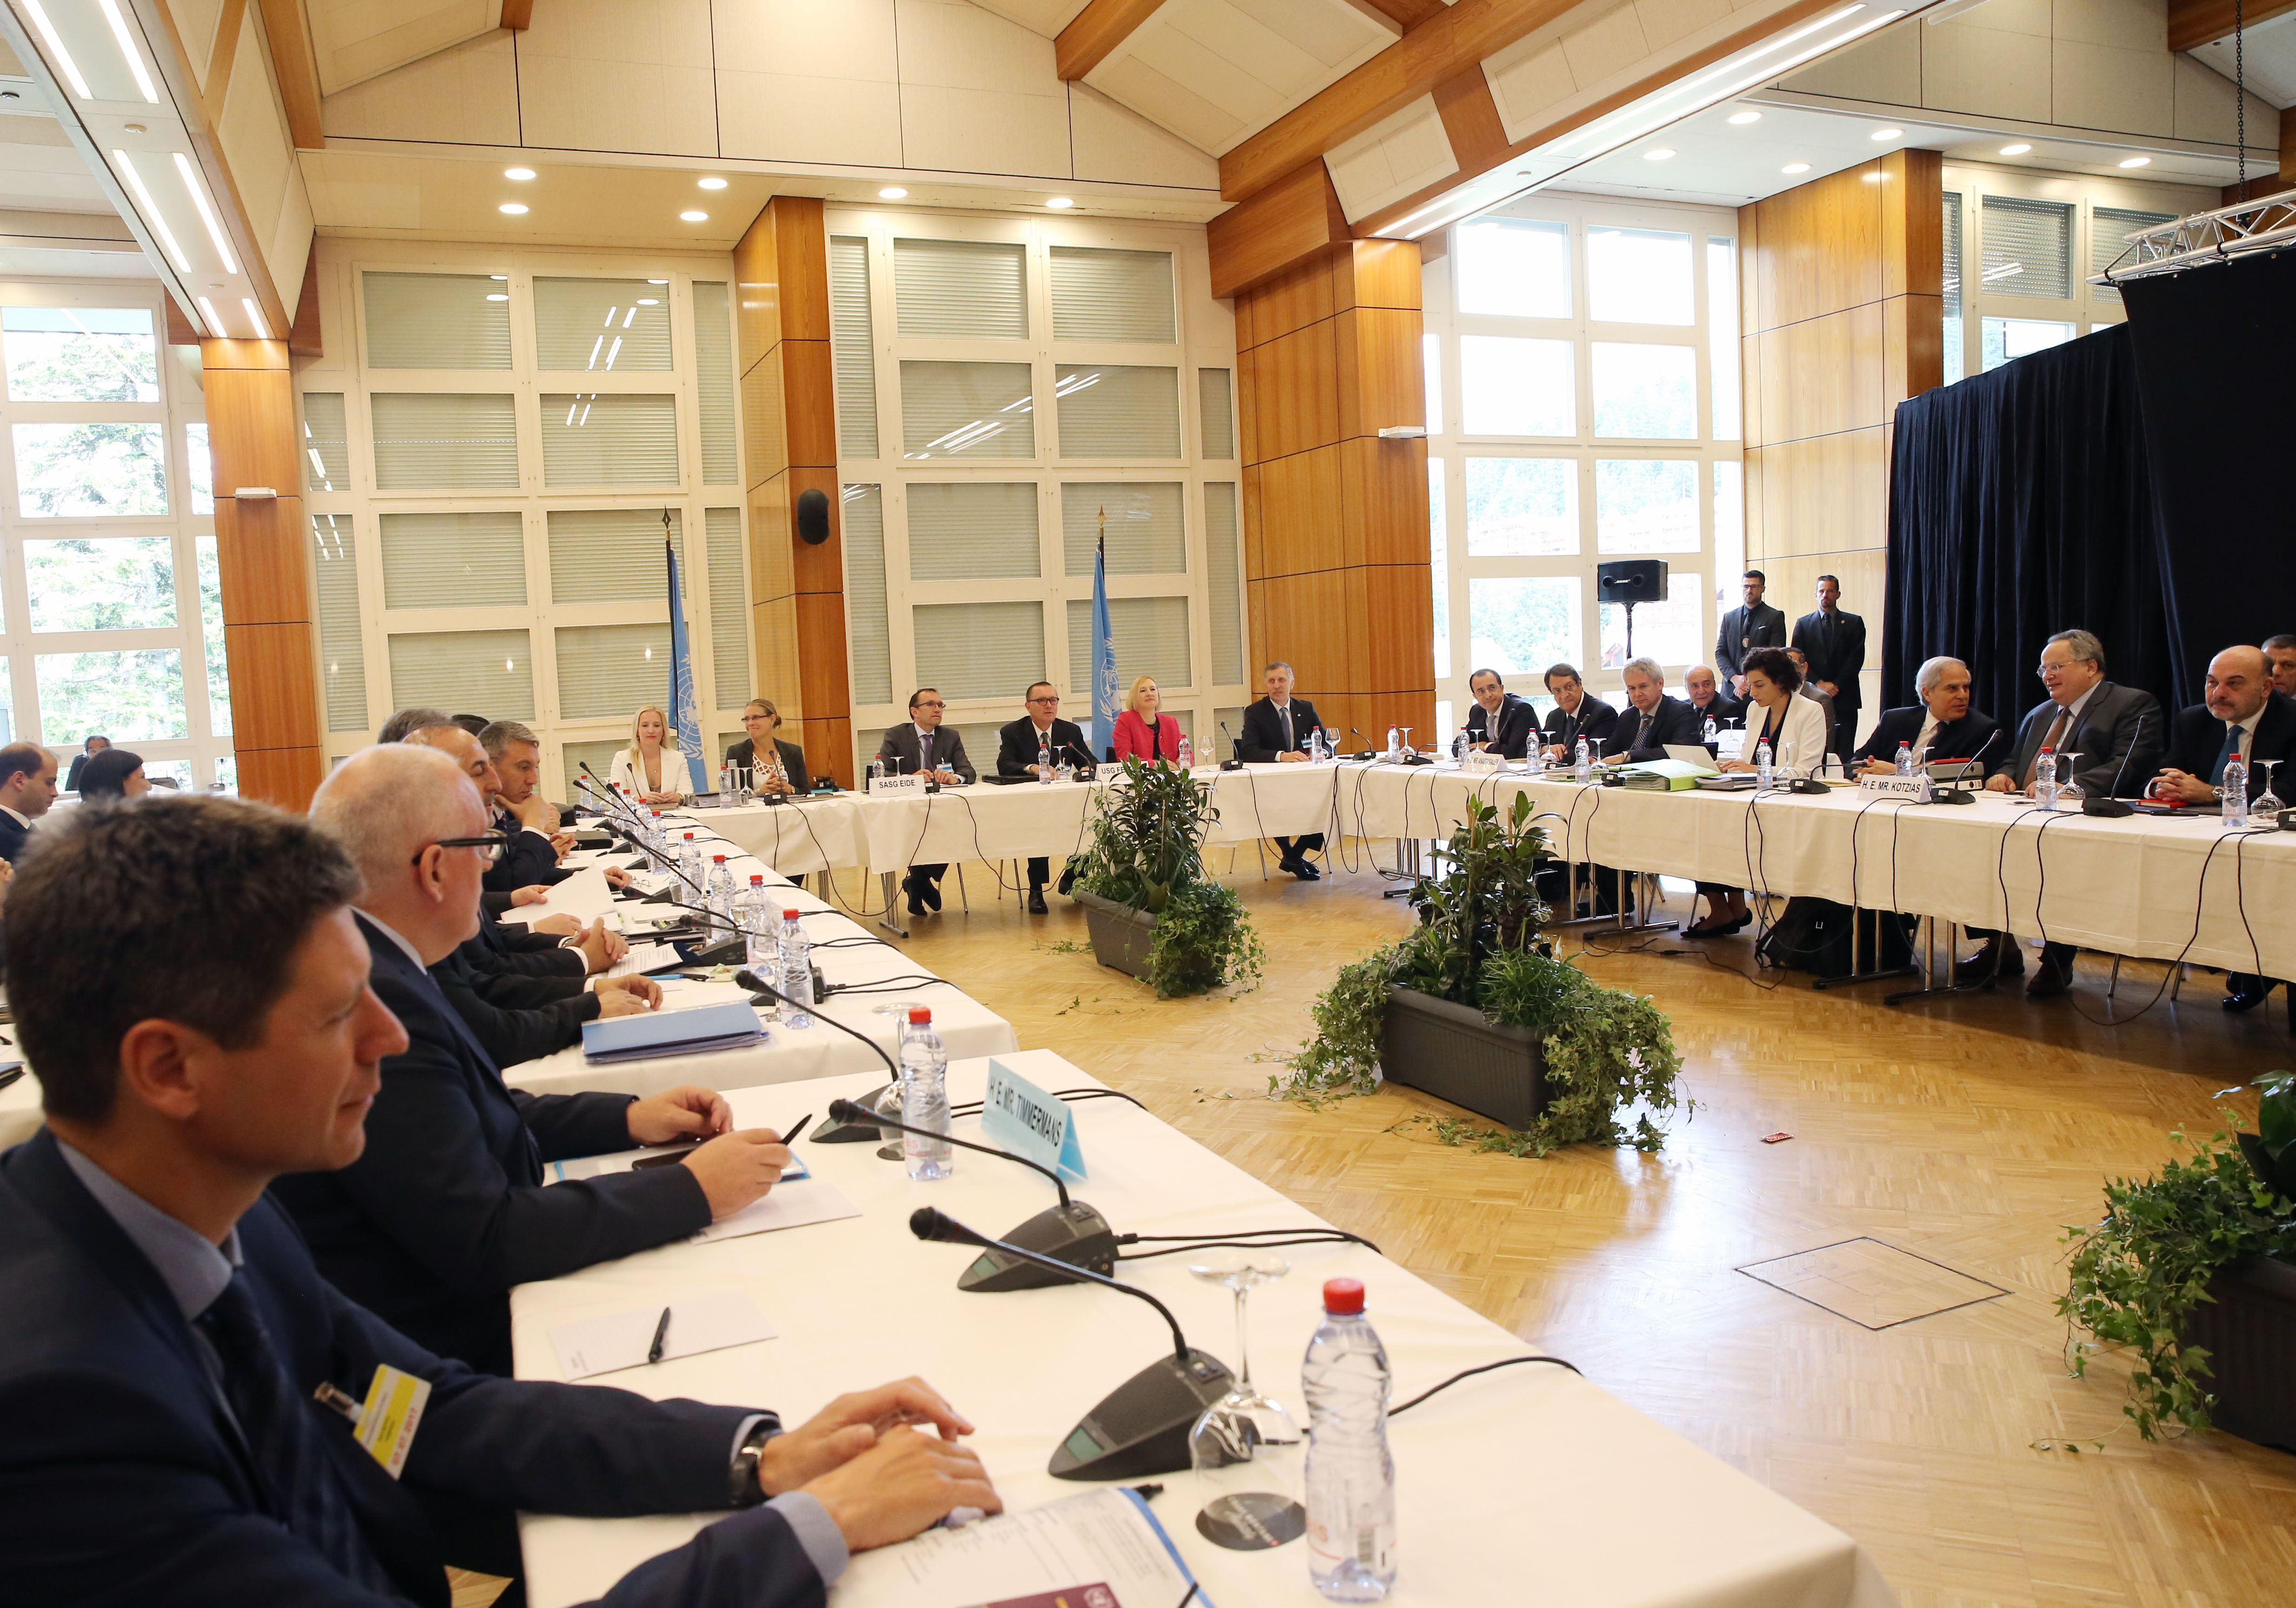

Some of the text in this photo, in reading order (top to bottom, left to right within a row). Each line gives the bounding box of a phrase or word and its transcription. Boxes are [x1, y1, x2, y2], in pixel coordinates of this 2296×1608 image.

[1862, 780, 1921, 793] H. E. MR. KOTZIAS
[1016, 1094, 1061, 1146] TIMMERMANS
